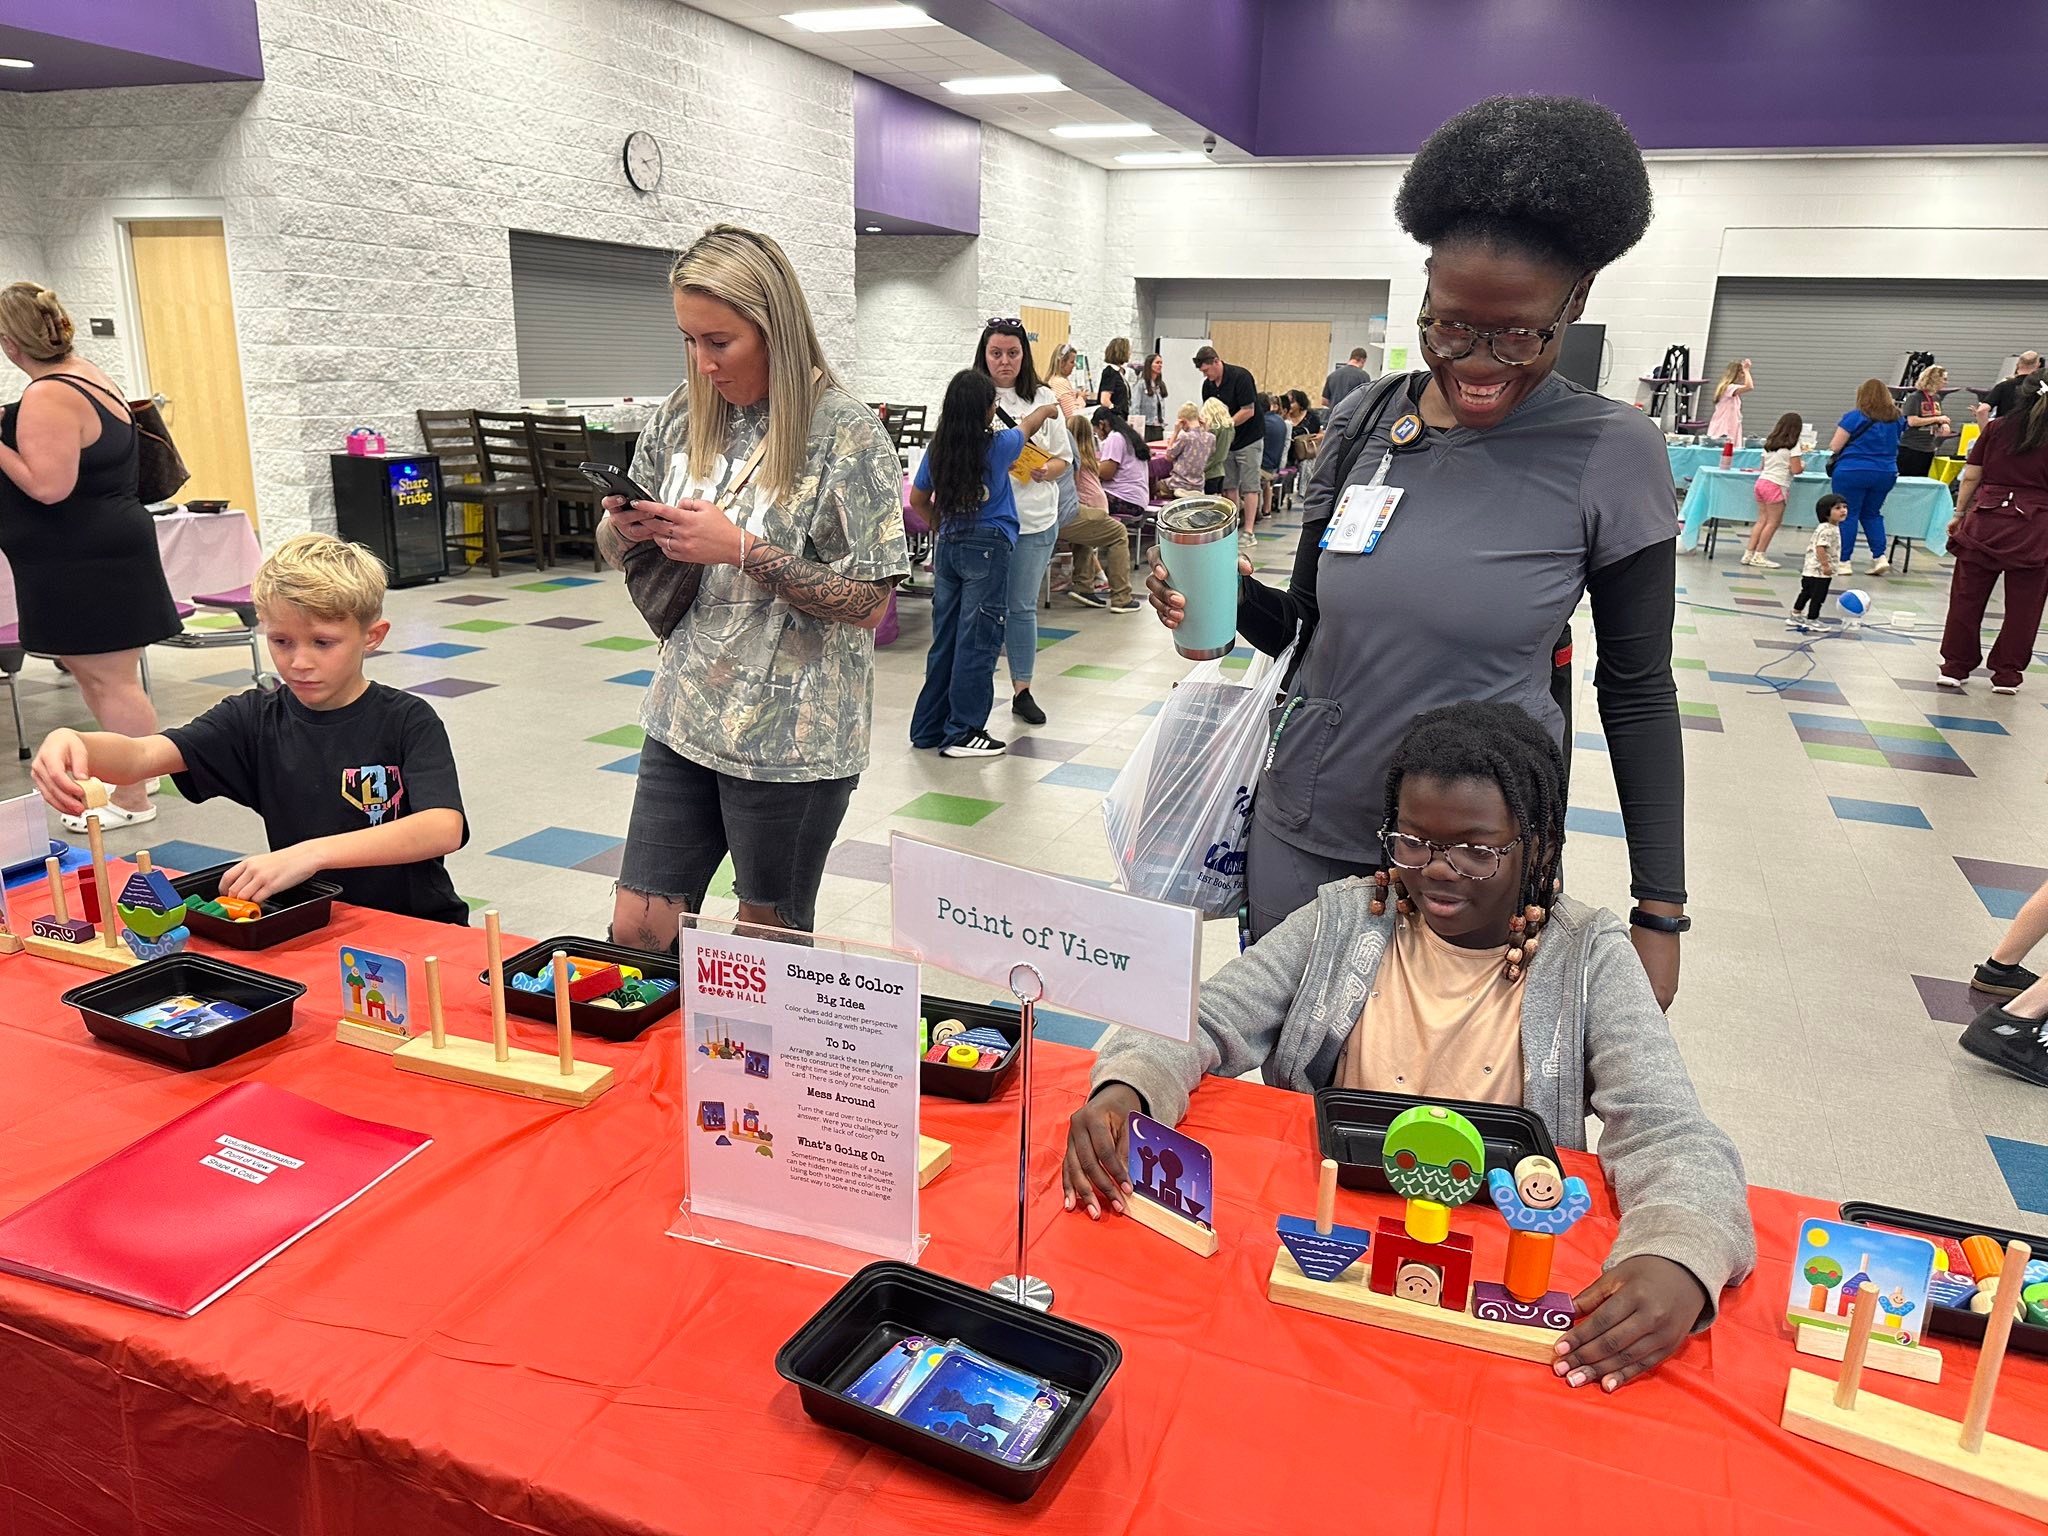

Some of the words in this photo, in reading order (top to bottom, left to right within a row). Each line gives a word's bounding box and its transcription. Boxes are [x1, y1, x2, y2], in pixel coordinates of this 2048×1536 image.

[398, 478, 429, 491] Share
[398, 491, 433, 506] Fridge
[937, 897, 1014, 939] Point
[1022, 927, 1054, 950] of
[1059, 931, 1130, 971] View
[697, 946, 766, 966] PENSACOLA
[698, 957, 767, 993] MESS
[787, 964, 834, 986] Shape
[839, 973, 851, 987] &
[855, 975, 904, 995] Color
[737, 991, 767, 1004] HALL
[817, 993, 837, 1007] Big
[840, 997, 865, 1010] Idea
[785, 1004, 801, 1012] Color
[803, 1008, 819, 1016] clues
[834, 1013, 859, 1022] another
[861, 1018, 898, 1029] perspective
[798, 1015, 816, 1023] when
[817, 1017, 842, 1029] building
[844, 1022, 858, 1030] with
[859, 1025, 883, 1035] shapes.
[826, 1037, 839, 1048] To
[842, 1040, 856, 1051] Do
[780, 1053, 800, 1061] pieces
[809, 1058, 838, 1068] construct
[839, 1062, 851, 1070] the
[872, 1069, 892, 1079] shown
[789, 1046, 813, 1056] Arrange
[829, 1053, 845, 1061] stack
[871, 1061, 894, 1072] playing
[792, 1071, 807, 1079] card.
[809, 1074, 827, 1082] There
[835, 1079, 848, 1087] only
[863, 1084, 891, 1094] solution.
[796, 1064, 813, 1072] night
[868, 1076, 898, 1088] challenge
[807, 1087, 832, 1100] Mess
[835, 1092, 875, 1108] Around
[797, 1104, 812, 1112] Turn
[864, 1118, 882, 1126] check
[883, 1121, 899, 1129] your
[853, 1122, 888, 1136] challenged
[890, 1131, 899, 1139] by
[224, 1137, 257, 1152] Volunteer
[834, 1144, 868, 1160] Going
[870, 1151, 885, 1162] On
[207, 1158, 231, 1170] Shape
[238, 1168, 258, 1180] Color
[224, 1150, 244, 1160] Point
[252, 1160, 269, 1170] View
[791, 1151, 825, 1163] Sometimes
[838, 1161, 859, 1169] details
[874, 1168, 893, 1177] shape
[808, 1163, 829, 1172] hidden
[831, 1167, 850, 1175] within
[790, 1166, 808, 1176] Using
[809, 1170, 823, 1178] both
[825, 1174, 843, 1183] shape
[790, 1174, 809, 1183] surest
[810, 1179, 823, 1187] way
[832, 1183, 848, 1191] solve
